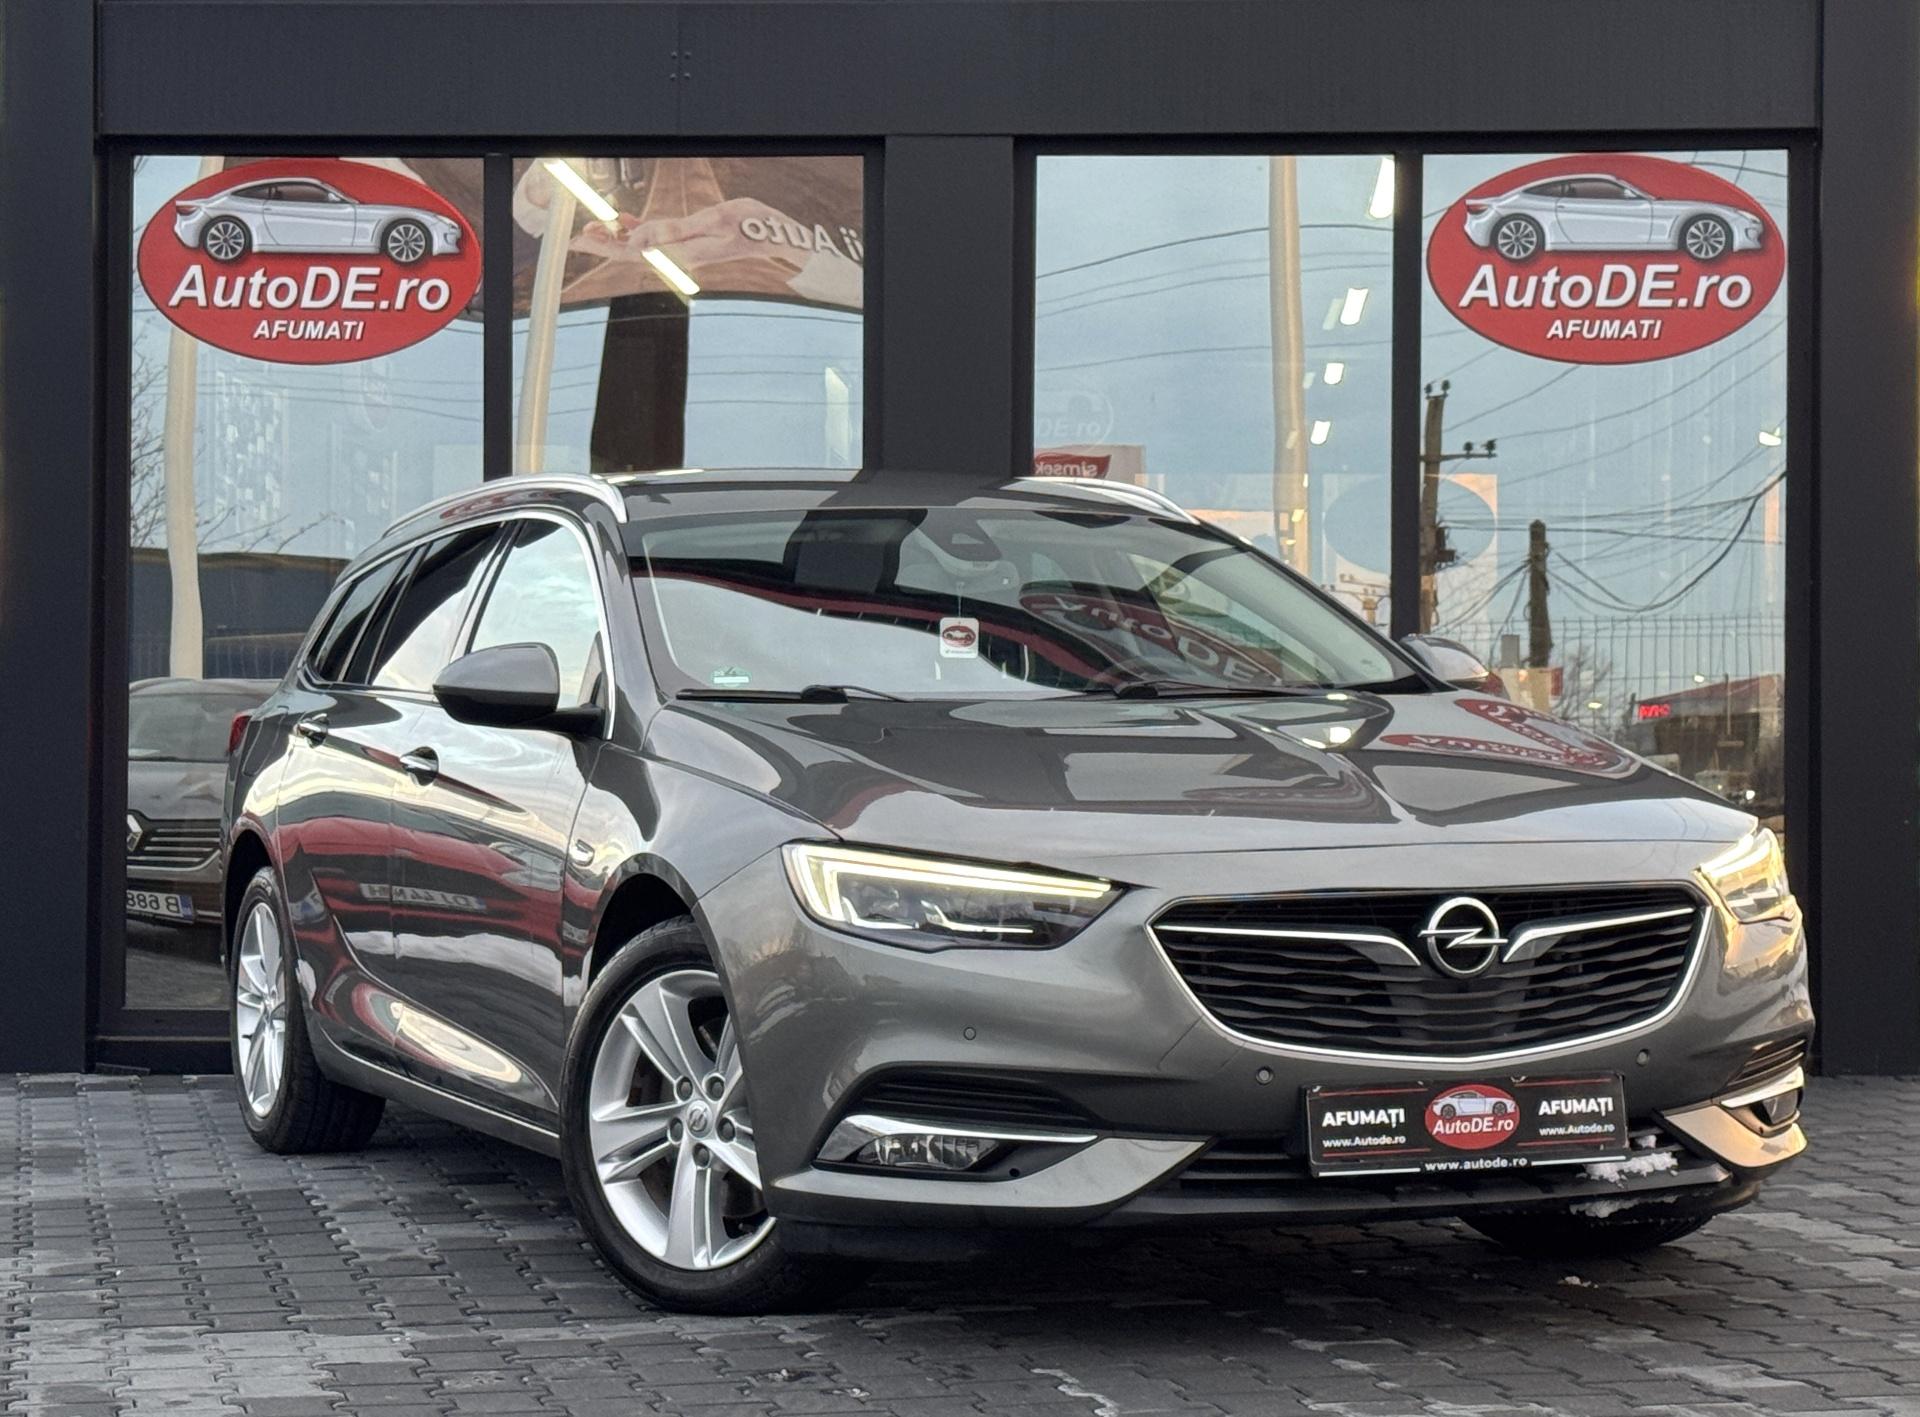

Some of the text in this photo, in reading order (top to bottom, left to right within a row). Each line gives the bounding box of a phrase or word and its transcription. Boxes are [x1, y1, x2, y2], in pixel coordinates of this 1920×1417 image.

[168, 264, 451, 312] AutoDE.ro
[1458, 263, 1753, 309] AutoDE.ro
[253, 319, 365, 341] AFUMATI
[1546, 319, 1662, 340] AFUMATI
[1538, 1097, 1613, 1116] AFUMAȚI
[1322, 1108, 1405, 1128] AFUMAȚI
[1432, 1117, 1514, 1136] AutoDE.ro
[1539, 1123, 1615, 1137] www.Autode.ro
[1322, 1134, 1406, 1148] www.Autode.ro
[1425, 1156, 1528, 1172] www.autode.ro
